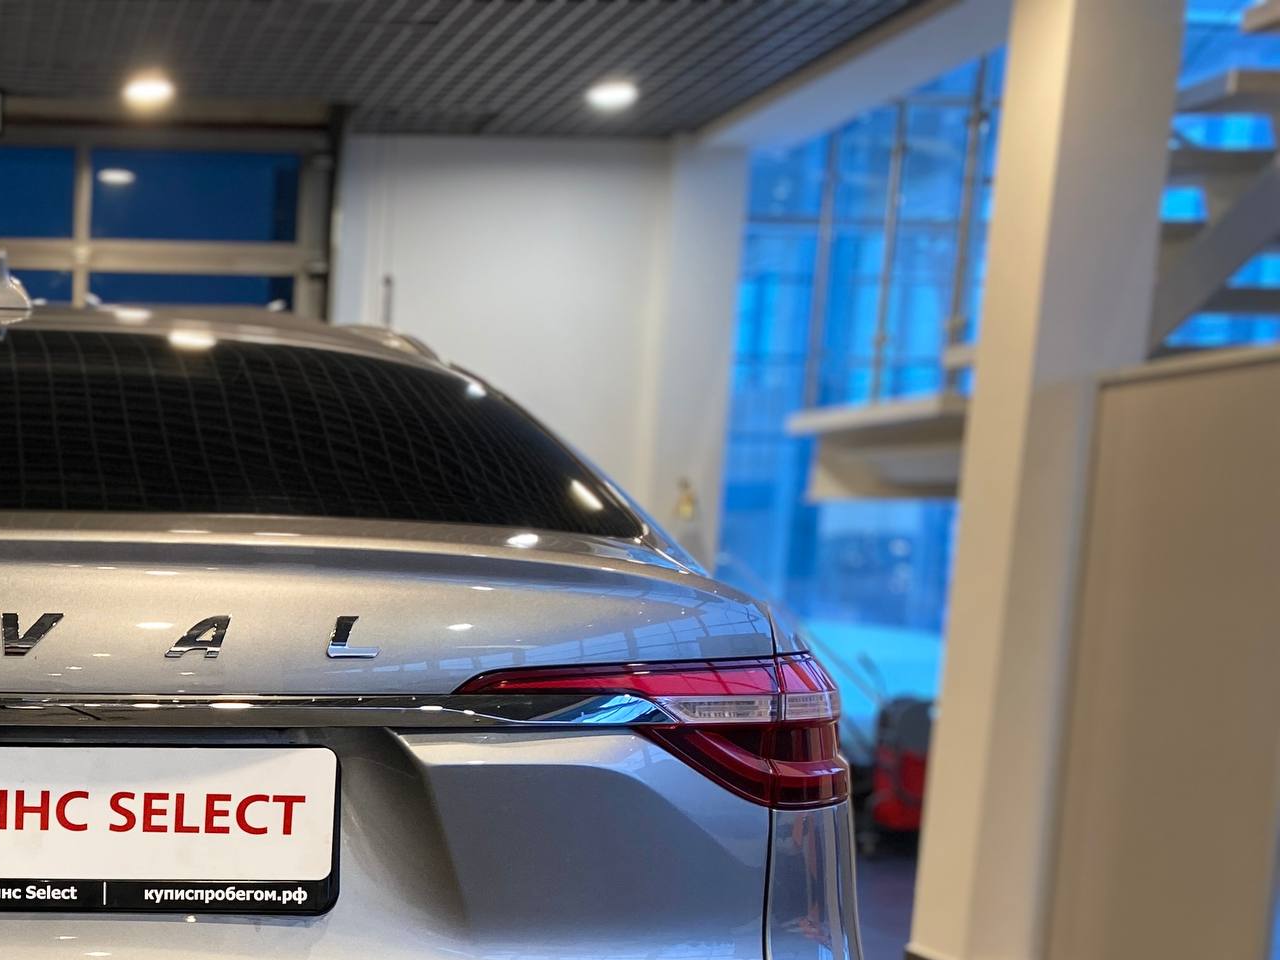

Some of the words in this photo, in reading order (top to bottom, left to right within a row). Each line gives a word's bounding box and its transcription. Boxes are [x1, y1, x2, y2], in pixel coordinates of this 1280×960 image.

[108, 791, 306, 835] SELECT
[25, 885, 77, 900] Select
[144, 887, 308, 904] куписпробегом.рф
